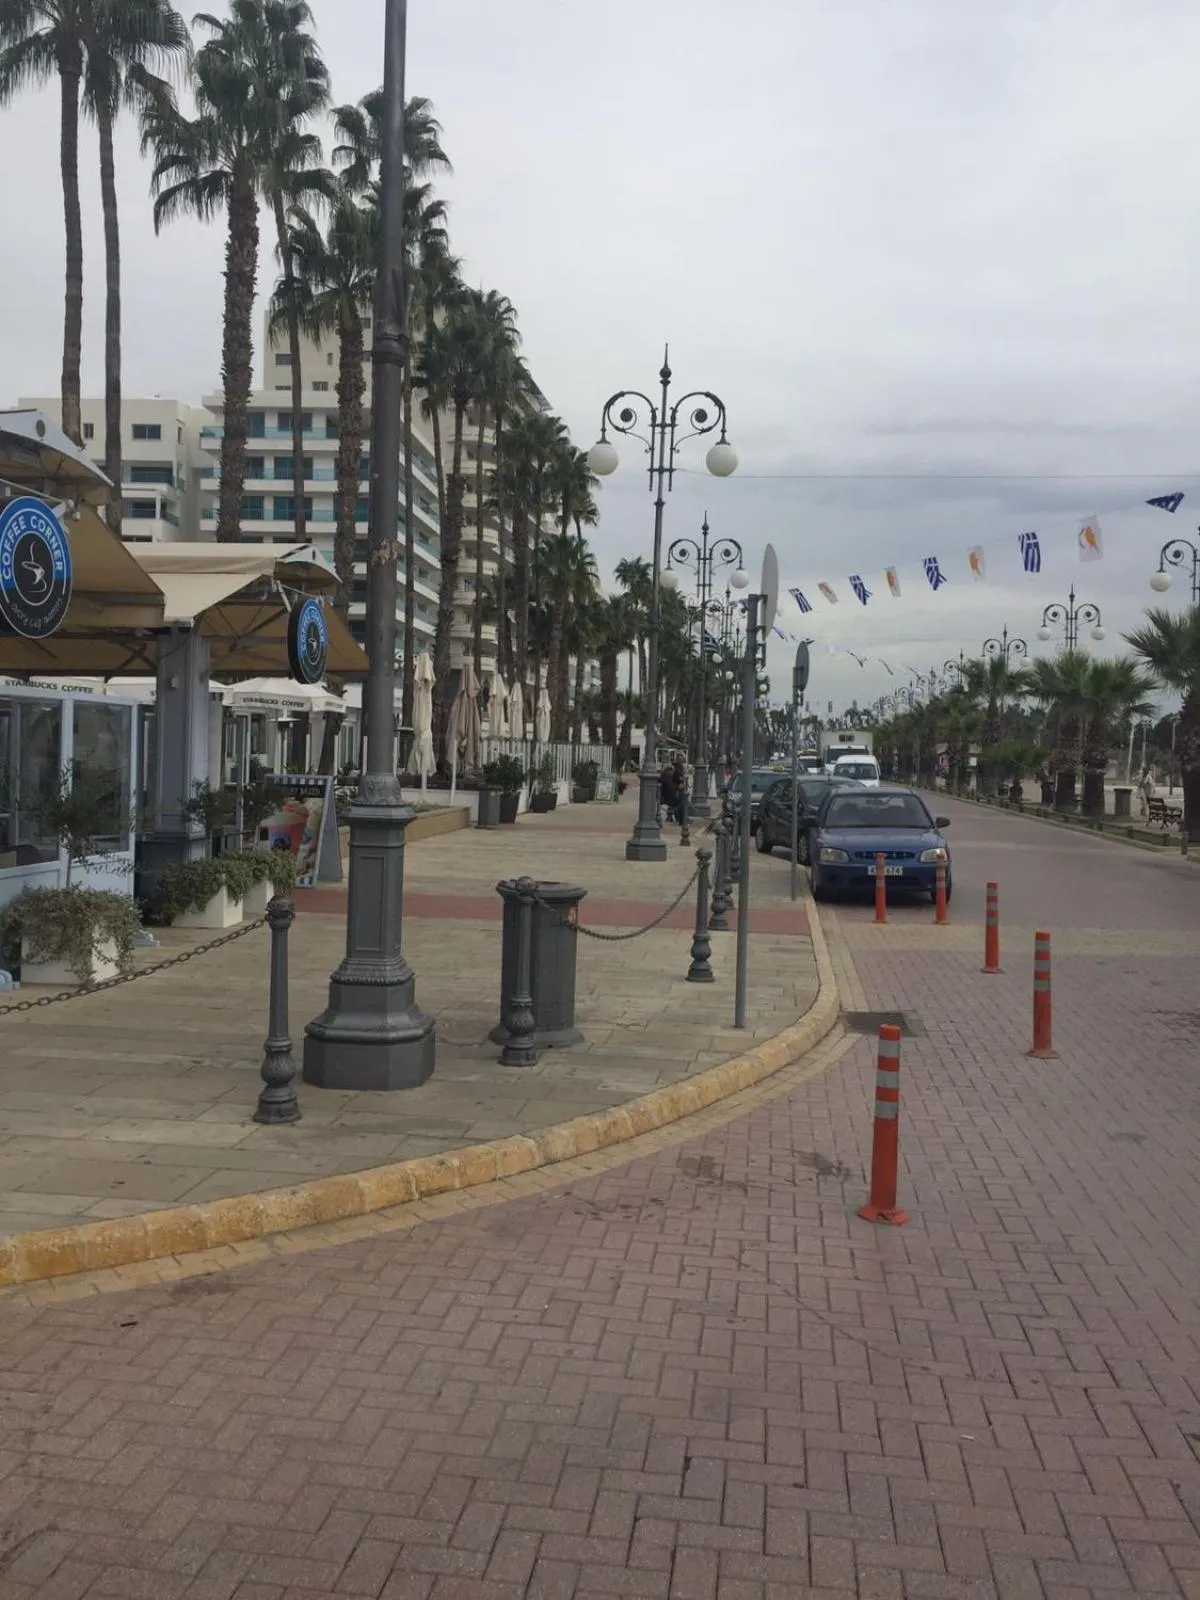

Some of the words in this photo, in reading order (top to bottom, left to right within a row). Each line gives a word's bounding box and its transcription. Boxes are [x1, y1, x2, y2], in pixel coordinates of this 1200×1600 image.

[2, 515, 26, 580] COFFEE
[30, 516, 63, 571] CORNER
[5, 679, 58, 690] STARBUCKS
[61, 684, 94, 694] COFFEE
[281, 699, 305, 708] COFFEE
